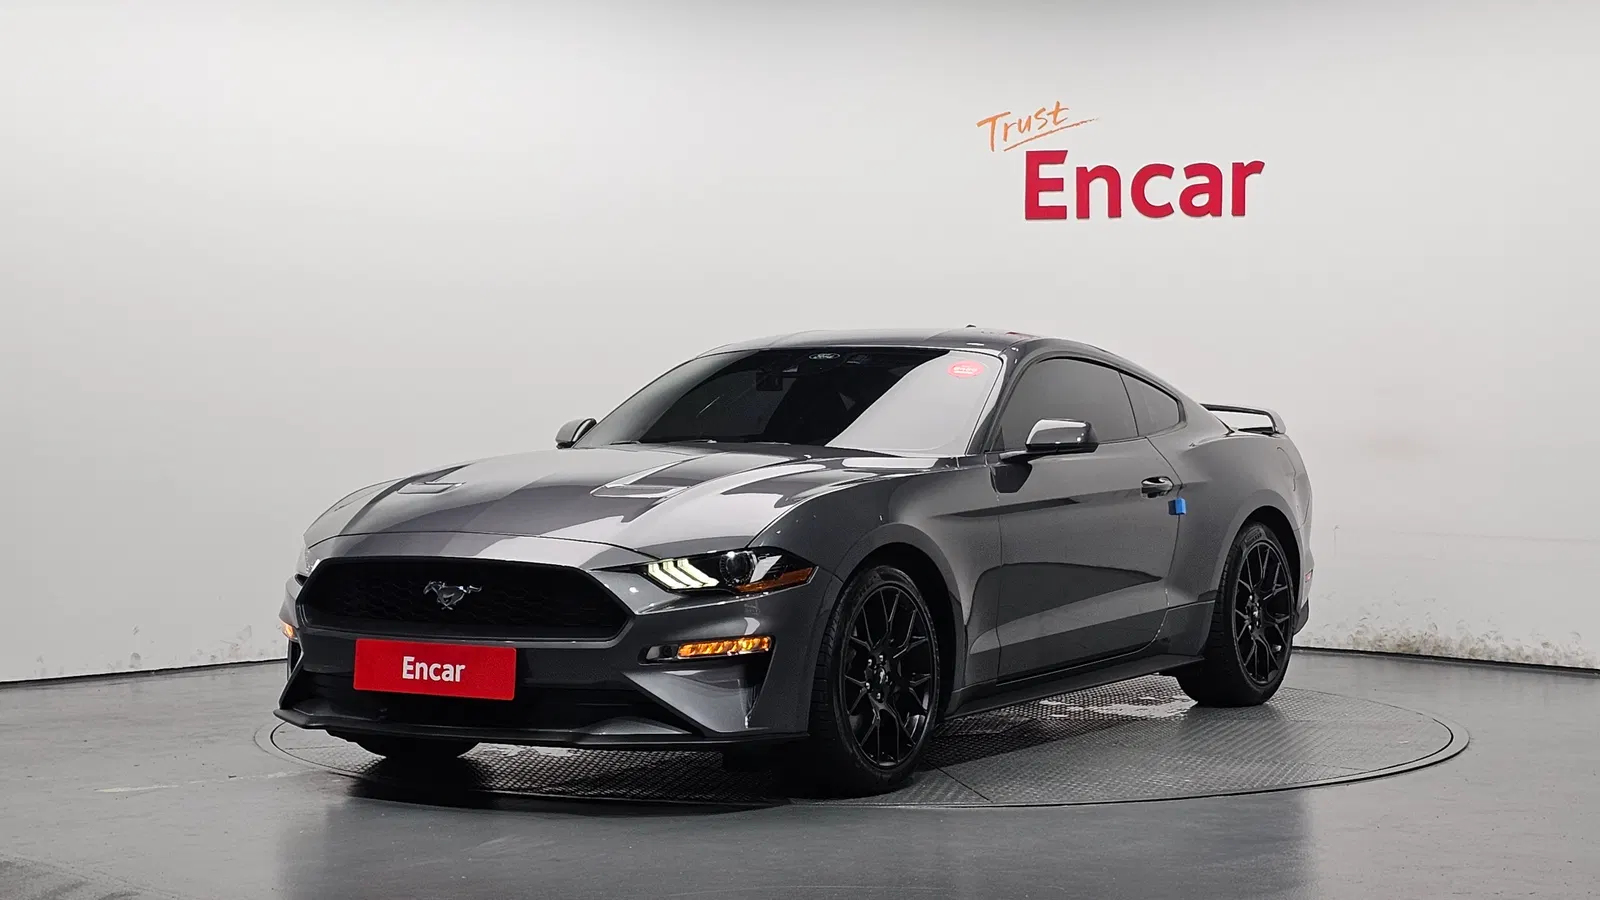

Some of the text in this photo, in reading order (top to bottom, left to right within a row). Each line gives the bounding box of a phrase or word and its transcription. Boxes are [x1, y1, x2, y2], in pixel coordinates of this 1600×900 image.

[976, 101, 1070, 151] Trust
[1024, 150, 1265, 220] Encar
[402, 656, 466, 682] Encar
